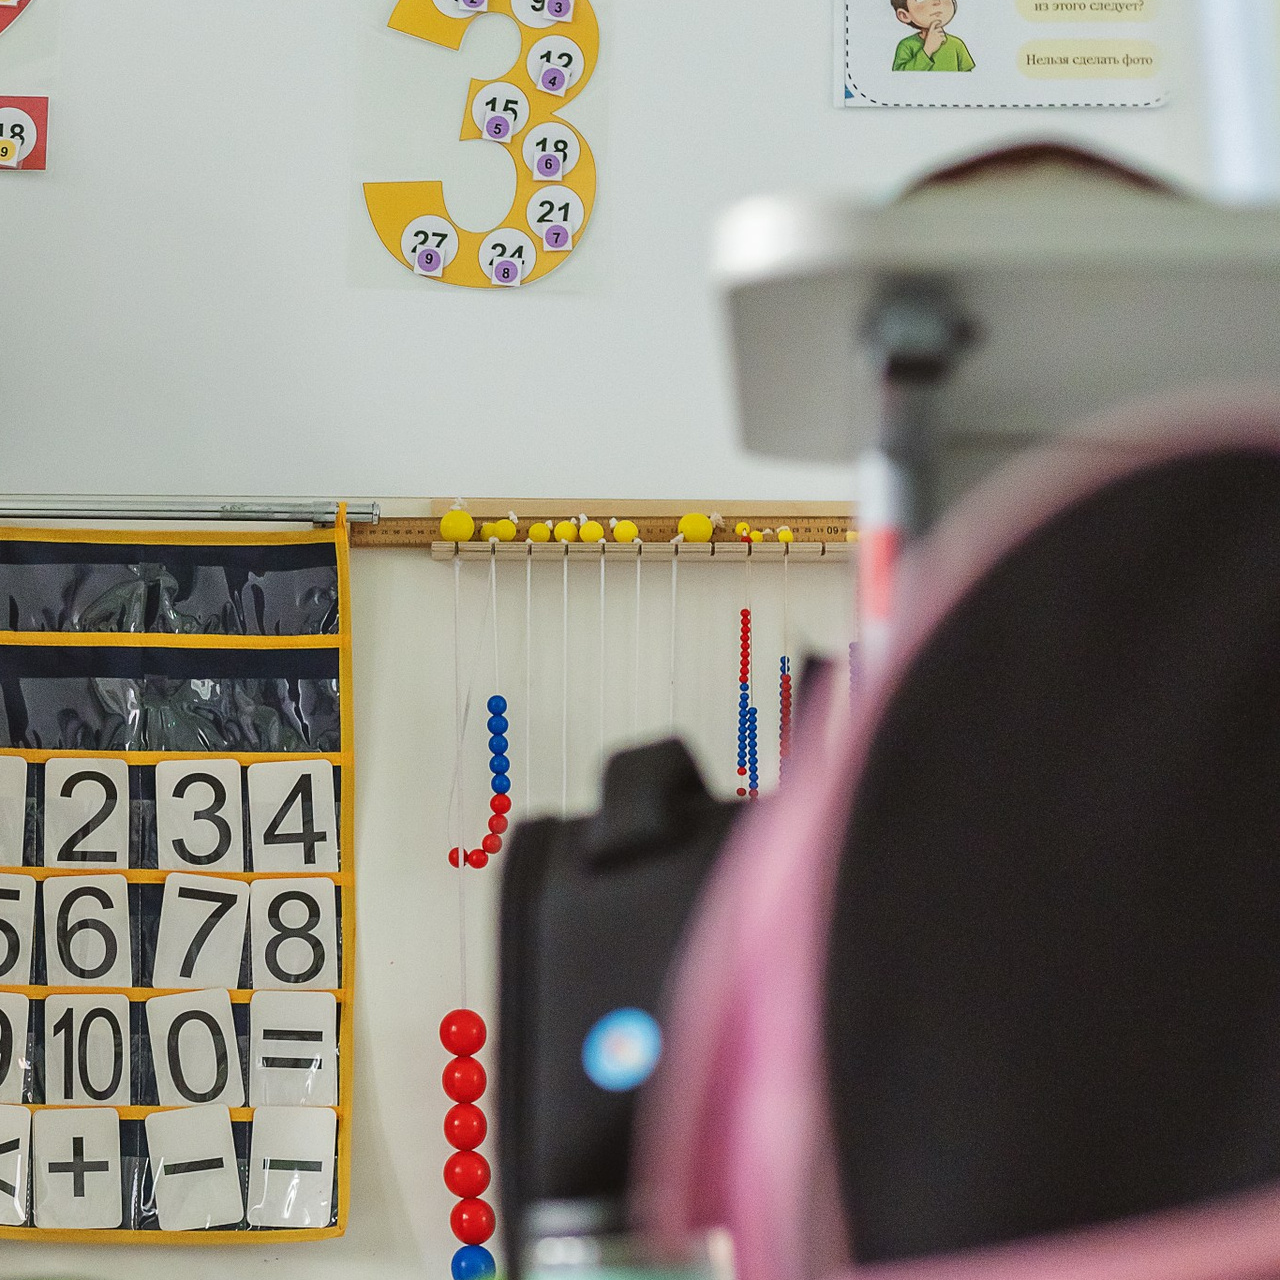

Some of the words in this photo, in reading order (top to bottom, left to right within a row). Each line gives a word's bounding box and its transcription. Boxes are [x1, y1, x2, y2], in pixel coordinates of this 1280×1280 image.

[555, 2, 563, 14] 3
[1052, 1, 1087, 12] этого
[1089, 0, 1144, 13] следует?
[1026, 54, 1070, 65] Нельзя
[1072, 55, 1119, 67] сделать
[1122, 54, 1153, 68] фото
[494, 123, 502, 135] 5
[0, 146, 8, 157] 9
[545, 158, 553, 170] 6
[537, 200, 570, 223] 21
[553, 233, 561, 244] 7
[56, 770, 119, 864] 2
[171, 771, 233, 866] 3
[262, 774, 327, 865] 4
[56, 886, 119, 980] 6
[176, 886, 238, 979] 7
[263, 890, 326, 984] 8
[52, 1006, 123, 1101] 10
[166, 1009, 230, 1103] 0
